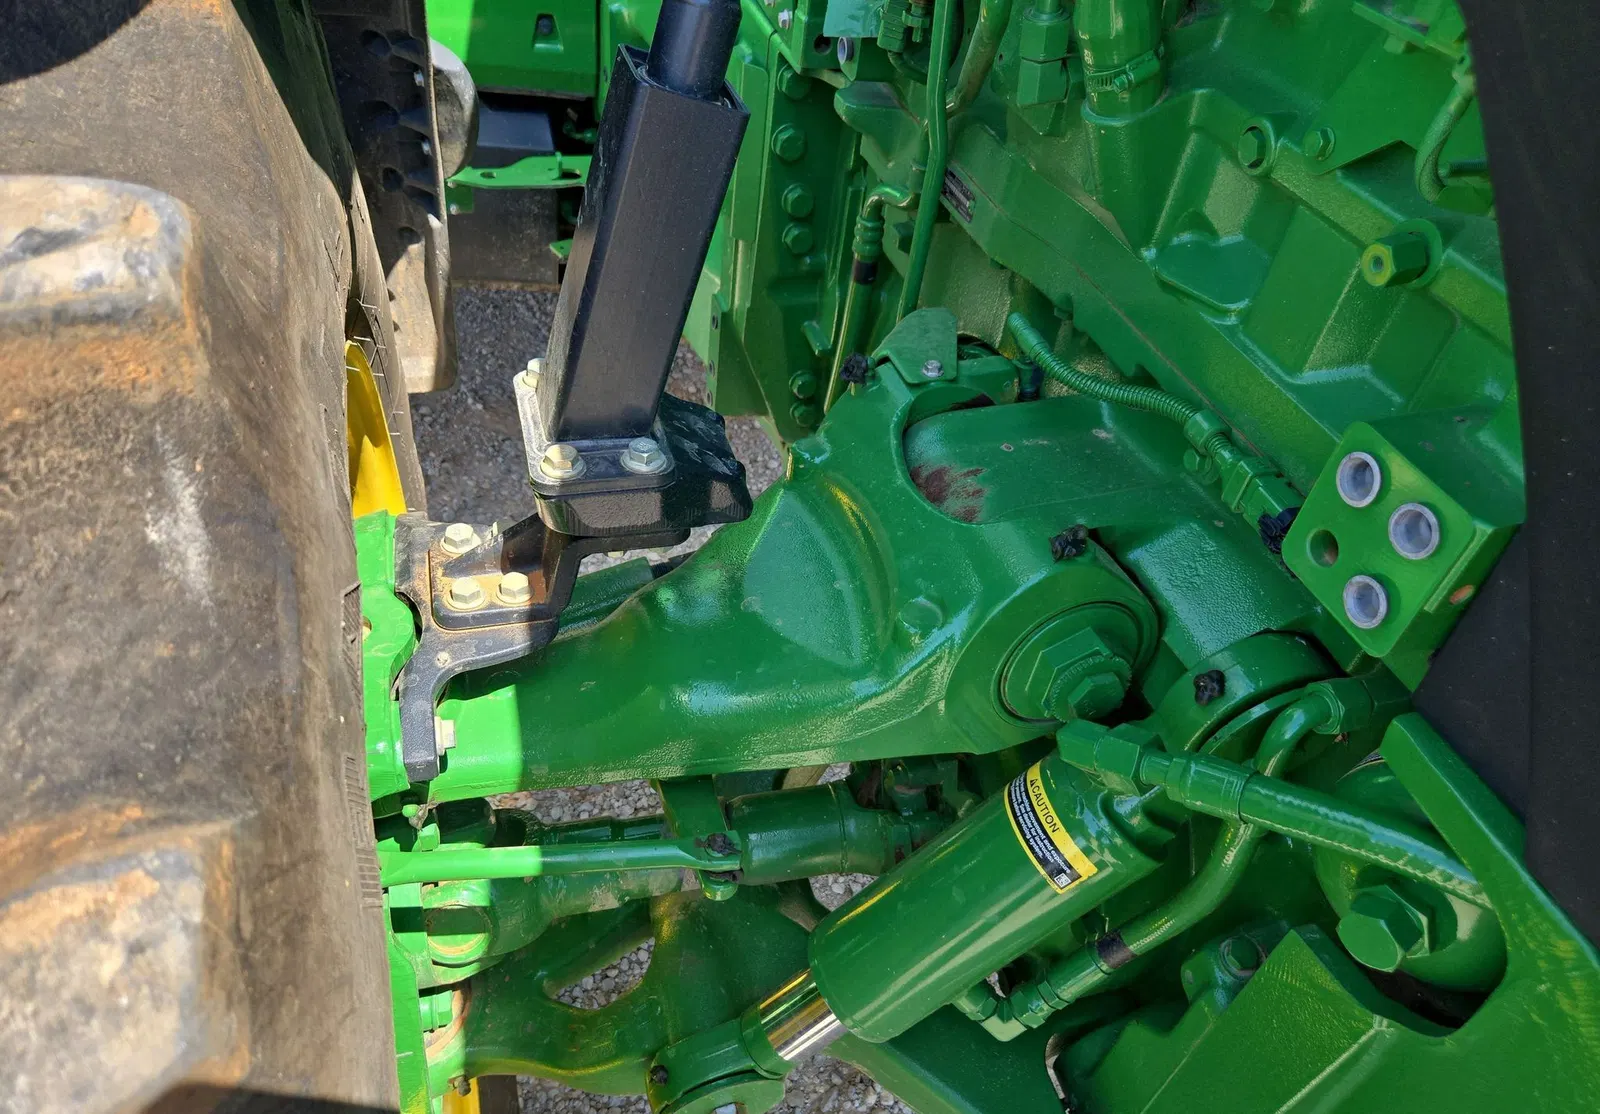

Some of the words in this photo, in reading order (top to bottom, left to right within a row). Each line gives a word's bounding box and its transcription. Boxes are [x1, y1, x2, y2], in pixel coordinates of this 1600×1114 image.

[1018, 815, 1032, 839] servicing
[1032, 785, 1060, 833] CAUTION
[1028, 811, 1046, 840] movement
[1043, 838, 1054, 851] and
[1051, 850, 1070, 873] exposure
[1034, 835, 1054, 863] instruction
